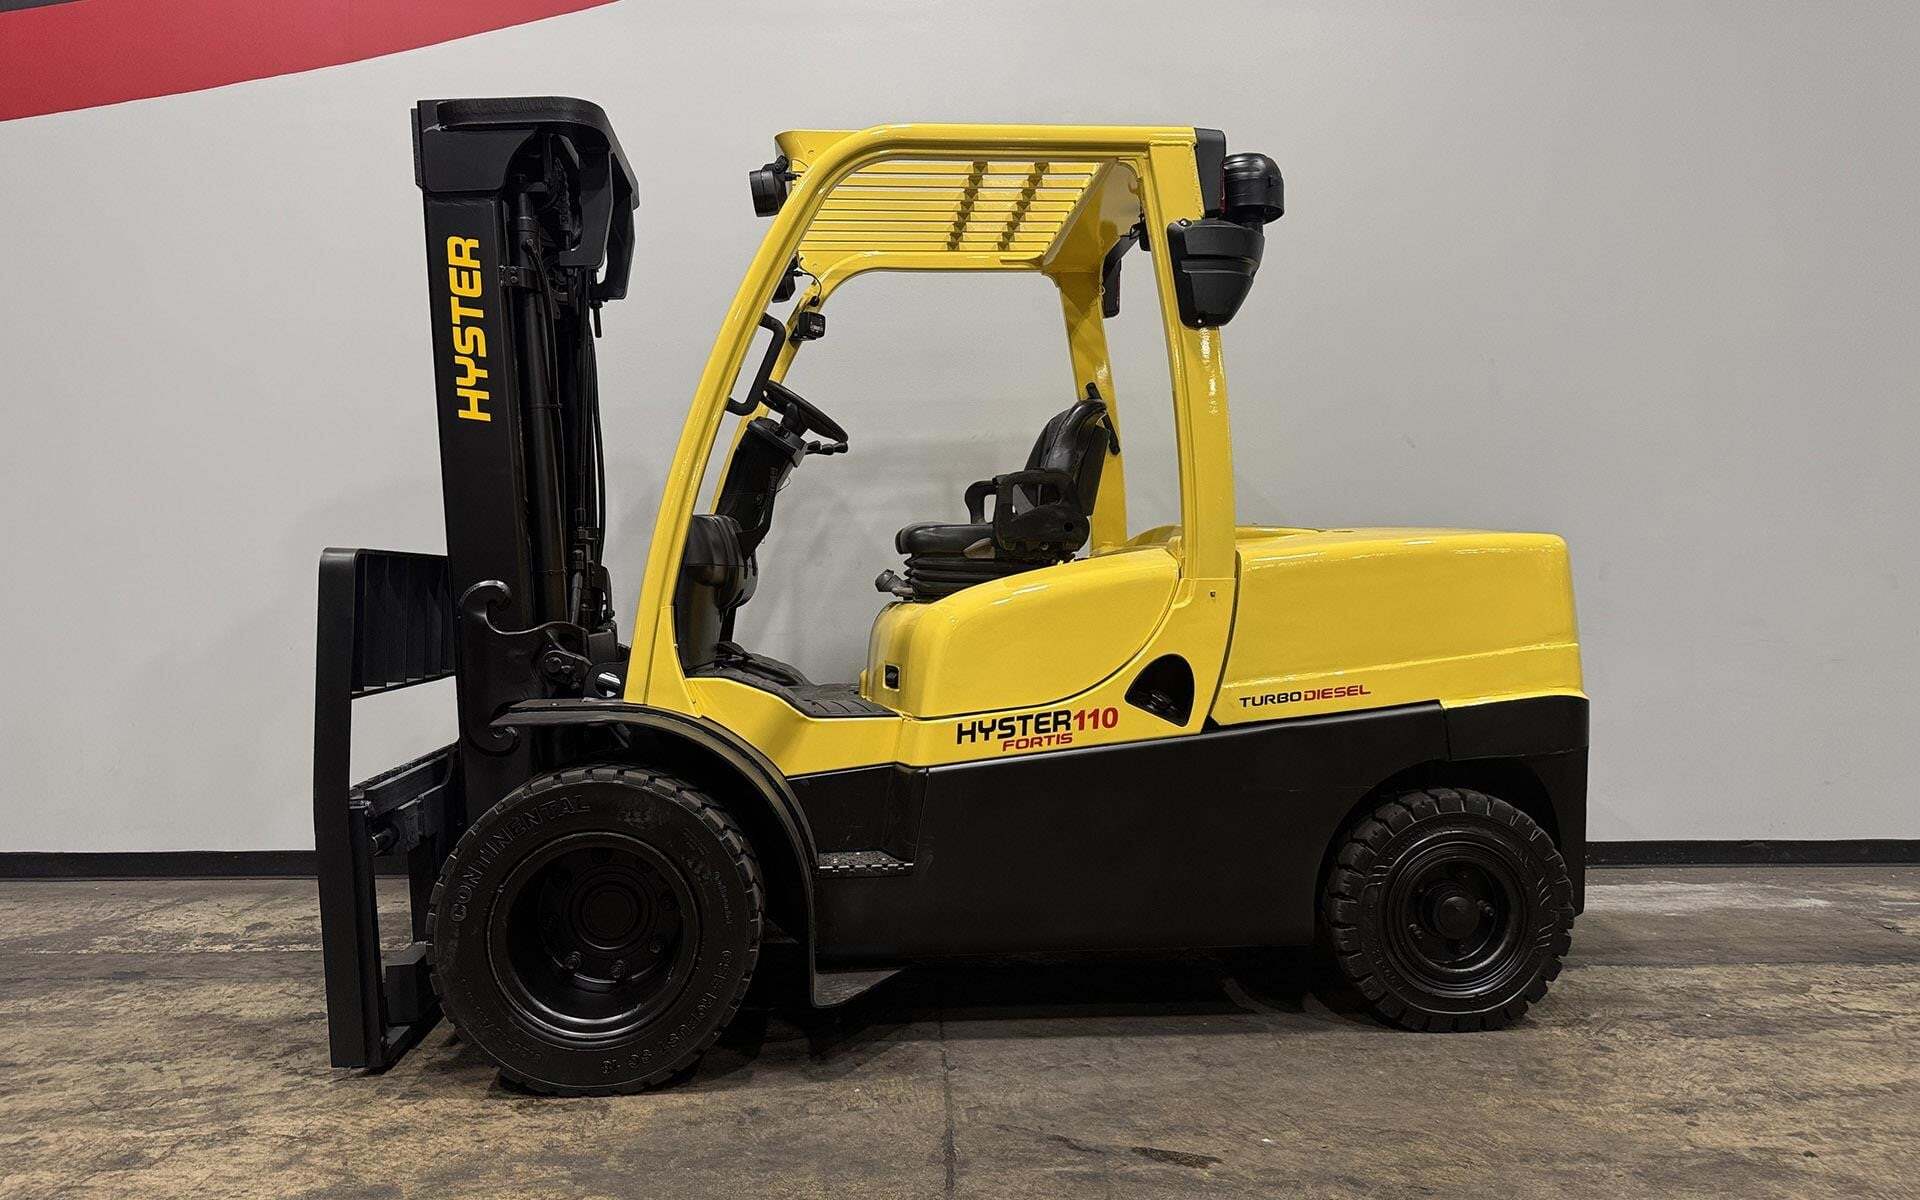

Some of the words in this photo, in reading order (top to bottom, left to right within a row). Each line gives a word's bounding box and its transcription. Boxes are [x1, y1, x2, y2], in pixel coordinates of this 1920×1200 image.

[446, 235, 491, 422] HYSTER
[956, 709, 1072, 745] HYSTER
[1073, 707, 1119, 731] 110
[1002, 733, 1073, 752] FORTIS
[452, 794, 592, 922] CONTINENTAL
